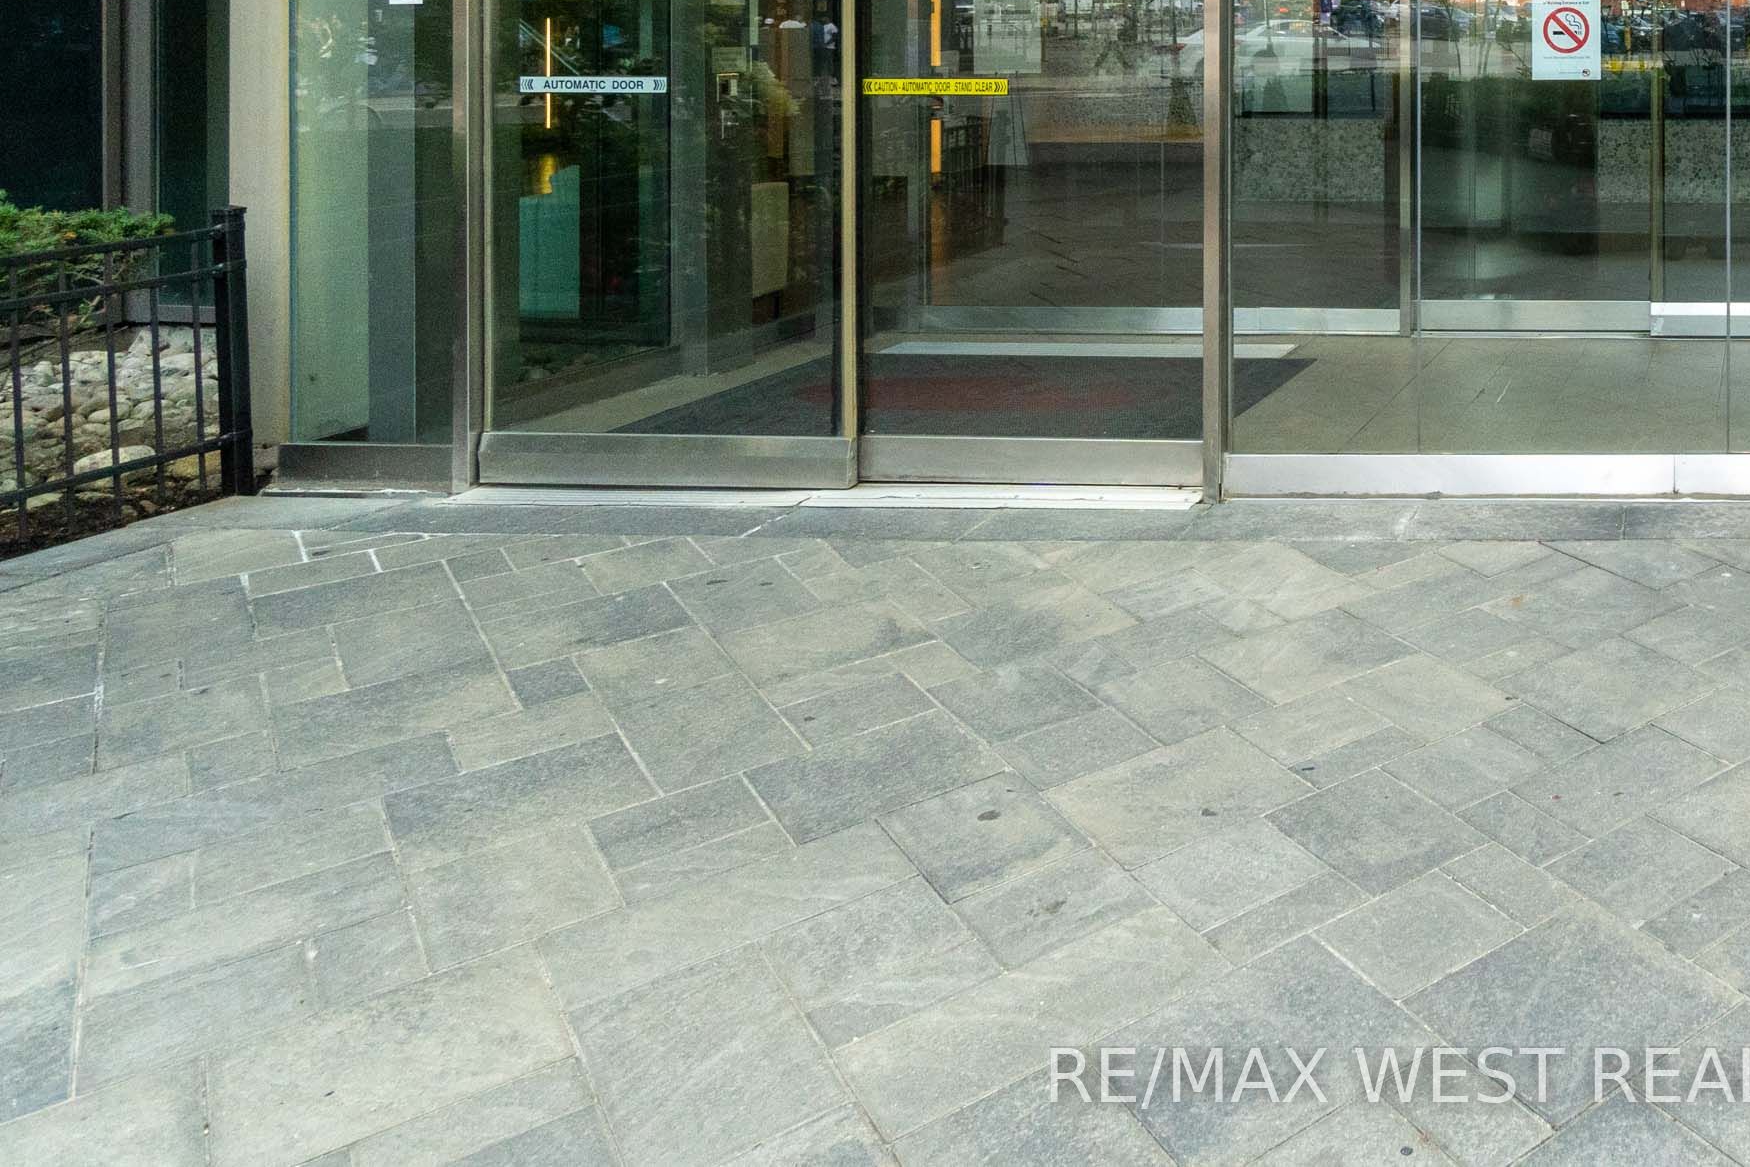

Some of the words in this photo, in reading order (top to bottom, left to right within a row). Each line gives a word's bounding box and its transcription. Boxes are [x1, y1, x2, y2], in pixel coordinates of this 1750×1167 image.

[543, 80, 606, 90] AUTOMATIC
[612, 80, 644, 90] DOOR
[873, 82, 898, 92] CAUTION
[934, 82, 951, 92] DOOR
[954, 82, 972, 92] STAND
[974, 82, 993, 92] CLEAR
